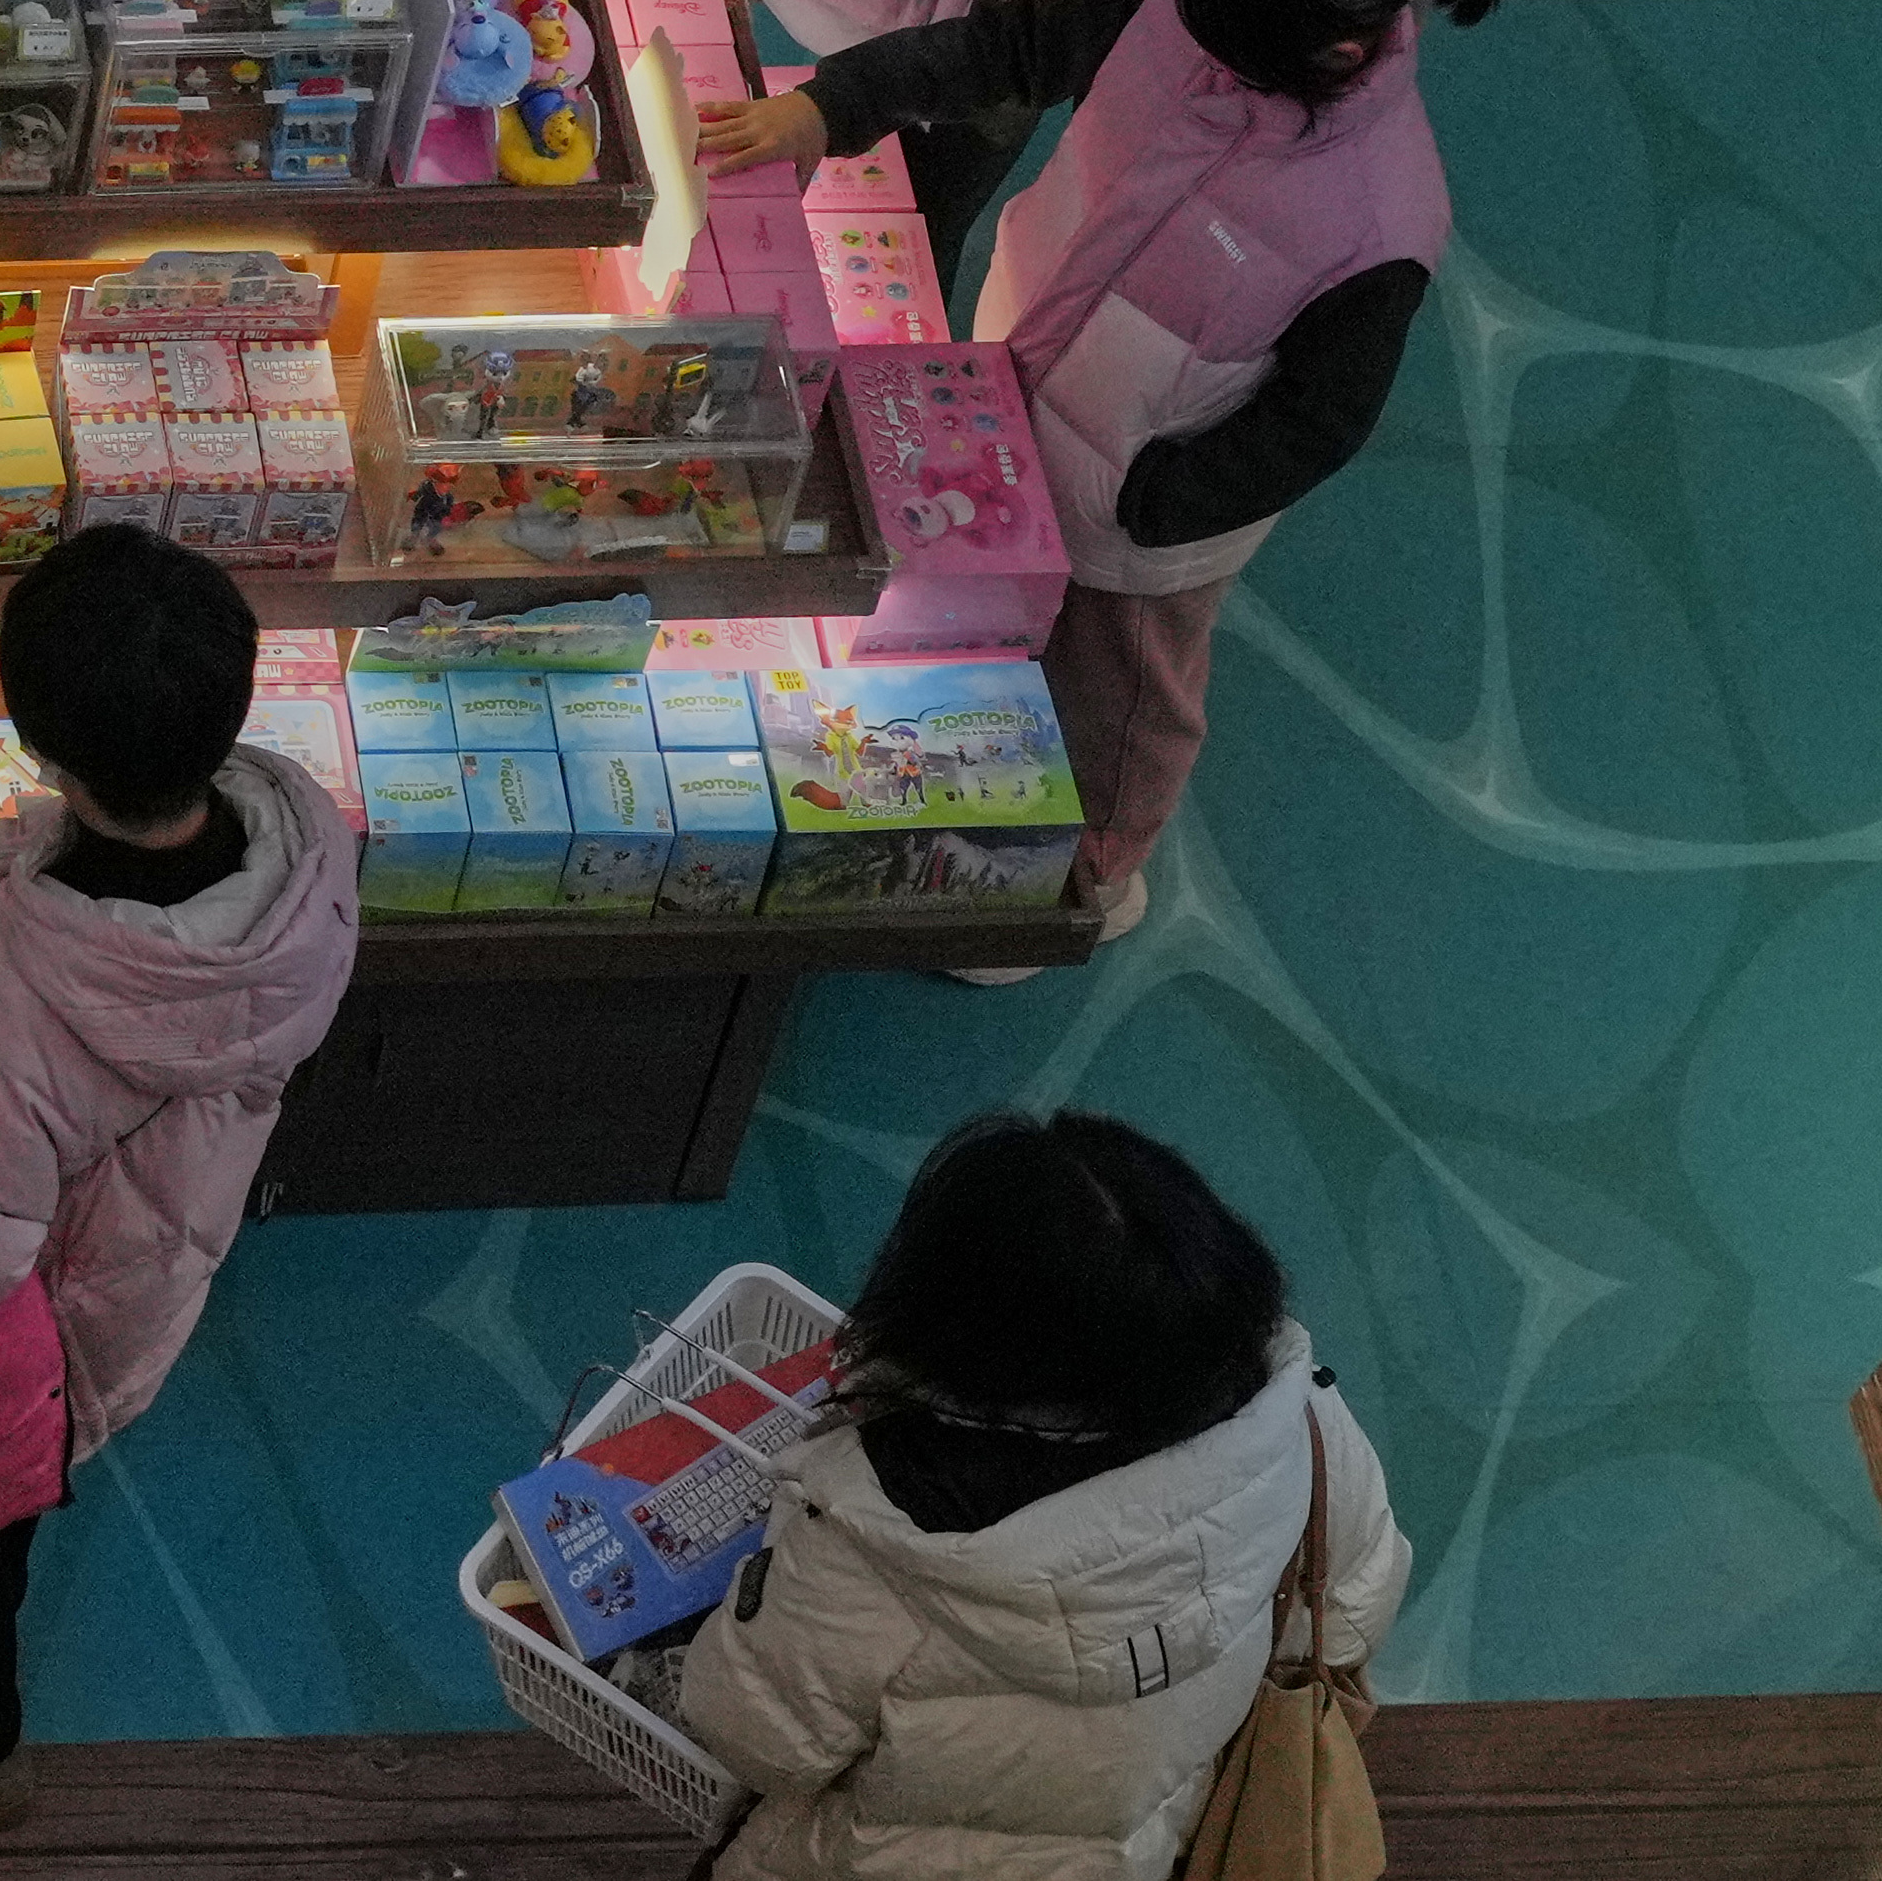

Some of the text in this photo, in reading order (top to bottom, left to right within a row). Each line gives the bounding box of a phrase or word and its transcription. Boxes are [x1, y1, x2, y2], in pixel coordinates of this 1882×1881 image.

[775, 671, 799, 681] TOP
[778, 681, 802, 690] TOY
[364, 699, 444, 714] ZOOTOPIA
[464, 699, 544, 714] ZOOTOPIA
[564, 700, 644, 715] ZOOTOPIA
[662, 696, 743, 710] ZOOTOPIA
[928, 711, 1036, 733] ZOOTOPIA
[500, 757, 526, 825] ZOOTOPIA
[610, 758, 633, 826] ZOOTOPIA
[681, 778, 763, 793] ZOOTOPIA
[374, 785, 457, 802] ZOOTOPIA
